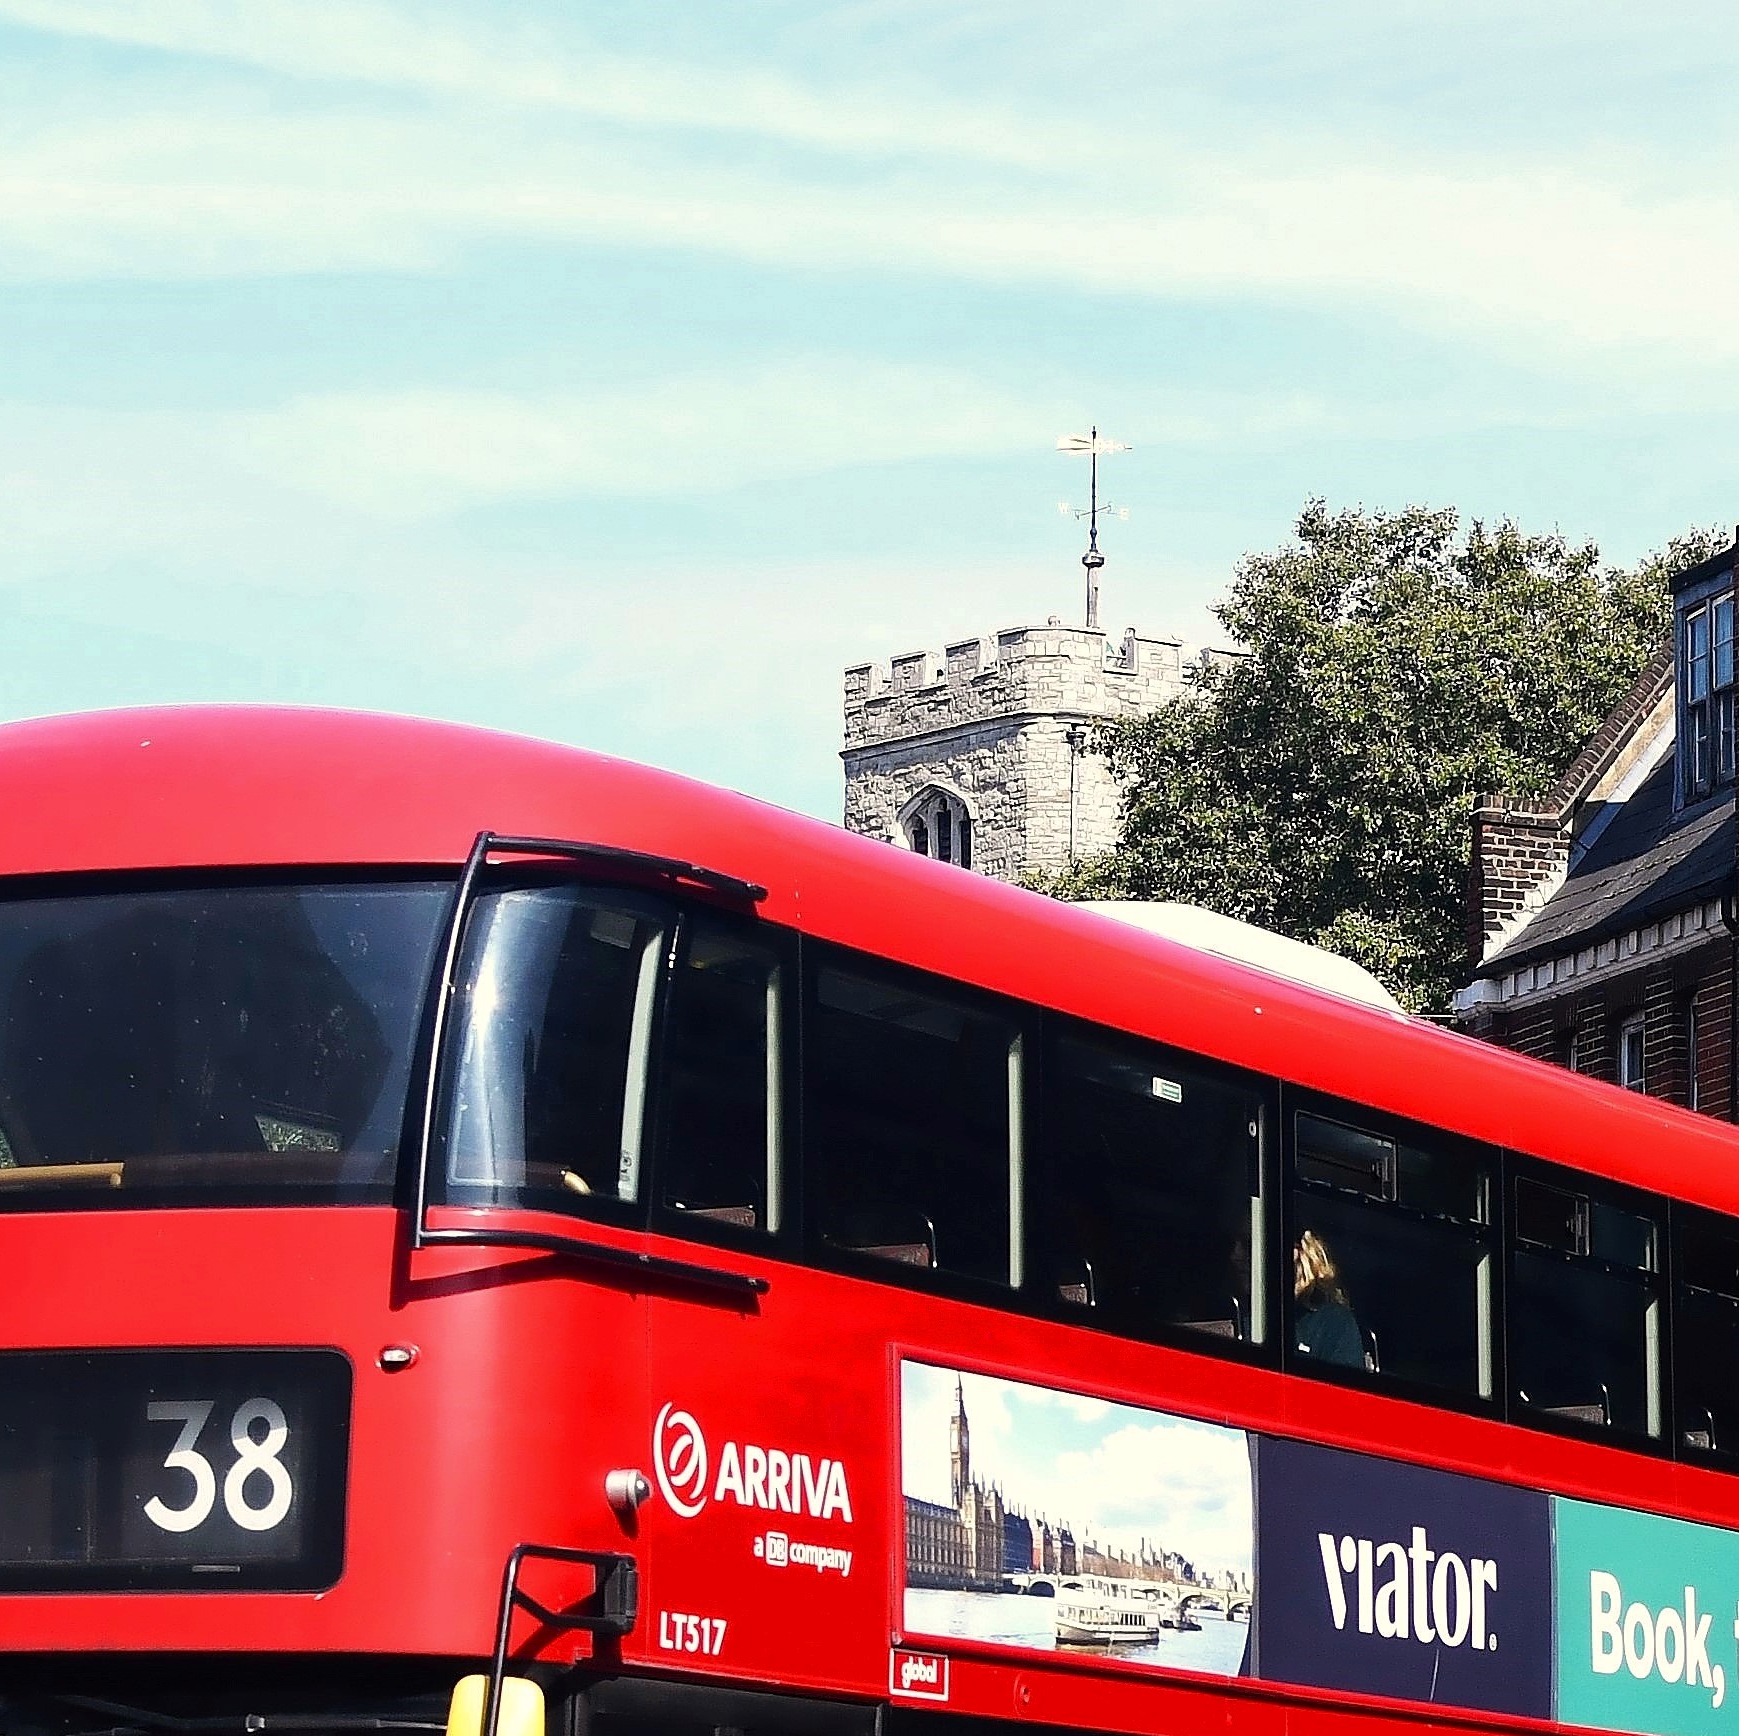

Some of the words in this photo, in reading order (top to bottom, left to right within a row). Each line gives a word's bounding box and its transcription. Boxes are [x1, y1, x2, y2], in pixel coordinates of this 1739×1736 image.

[144, 1397, 294, 1533] 38
[714, 1441, 854, 1524] ARRIVA
[753, 1536, 764, 1558] a
[768, 1534, 787, 1565] DB
[789, 1541, 853, 1578] company
[659, 1610, 728, 1657] LT517
[1589, 1569, 1725, 1709] Book,
[901, 1655, 938, 1689] global
